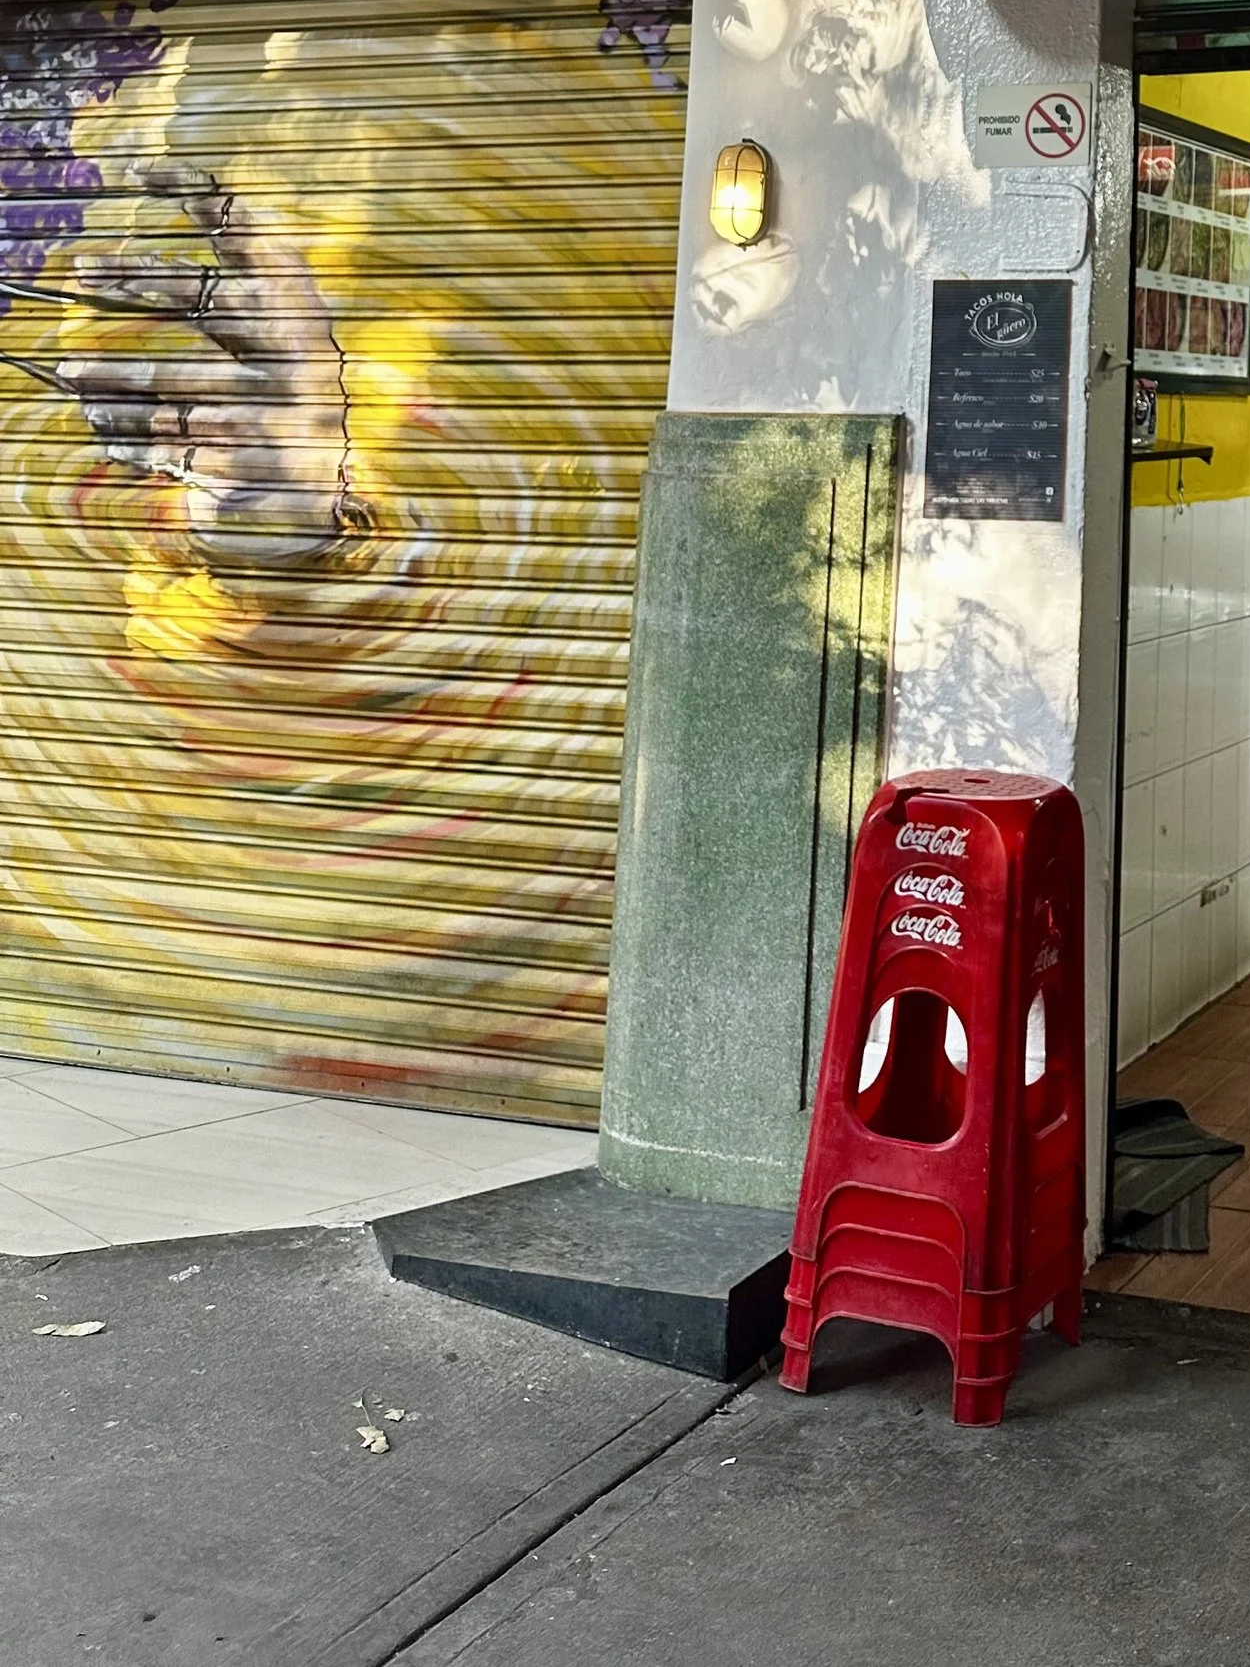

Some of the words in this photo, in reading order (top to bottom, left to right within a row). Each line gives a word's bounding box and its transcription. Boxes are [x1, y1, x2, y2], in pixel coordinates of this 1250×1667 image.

[979, 115, 1020, 125] PROHIBIDO
[985, 127, 1012, 135] FUMAR
[964, 294, 993, 321] TACOS
[996, 292, 1023, 303] HOLA
[896, 822, 968, 856] Coca-Cola
[894, 871, 965, 906] Coca-Cola
[891, 911, 962, 946] Coca-Cola
